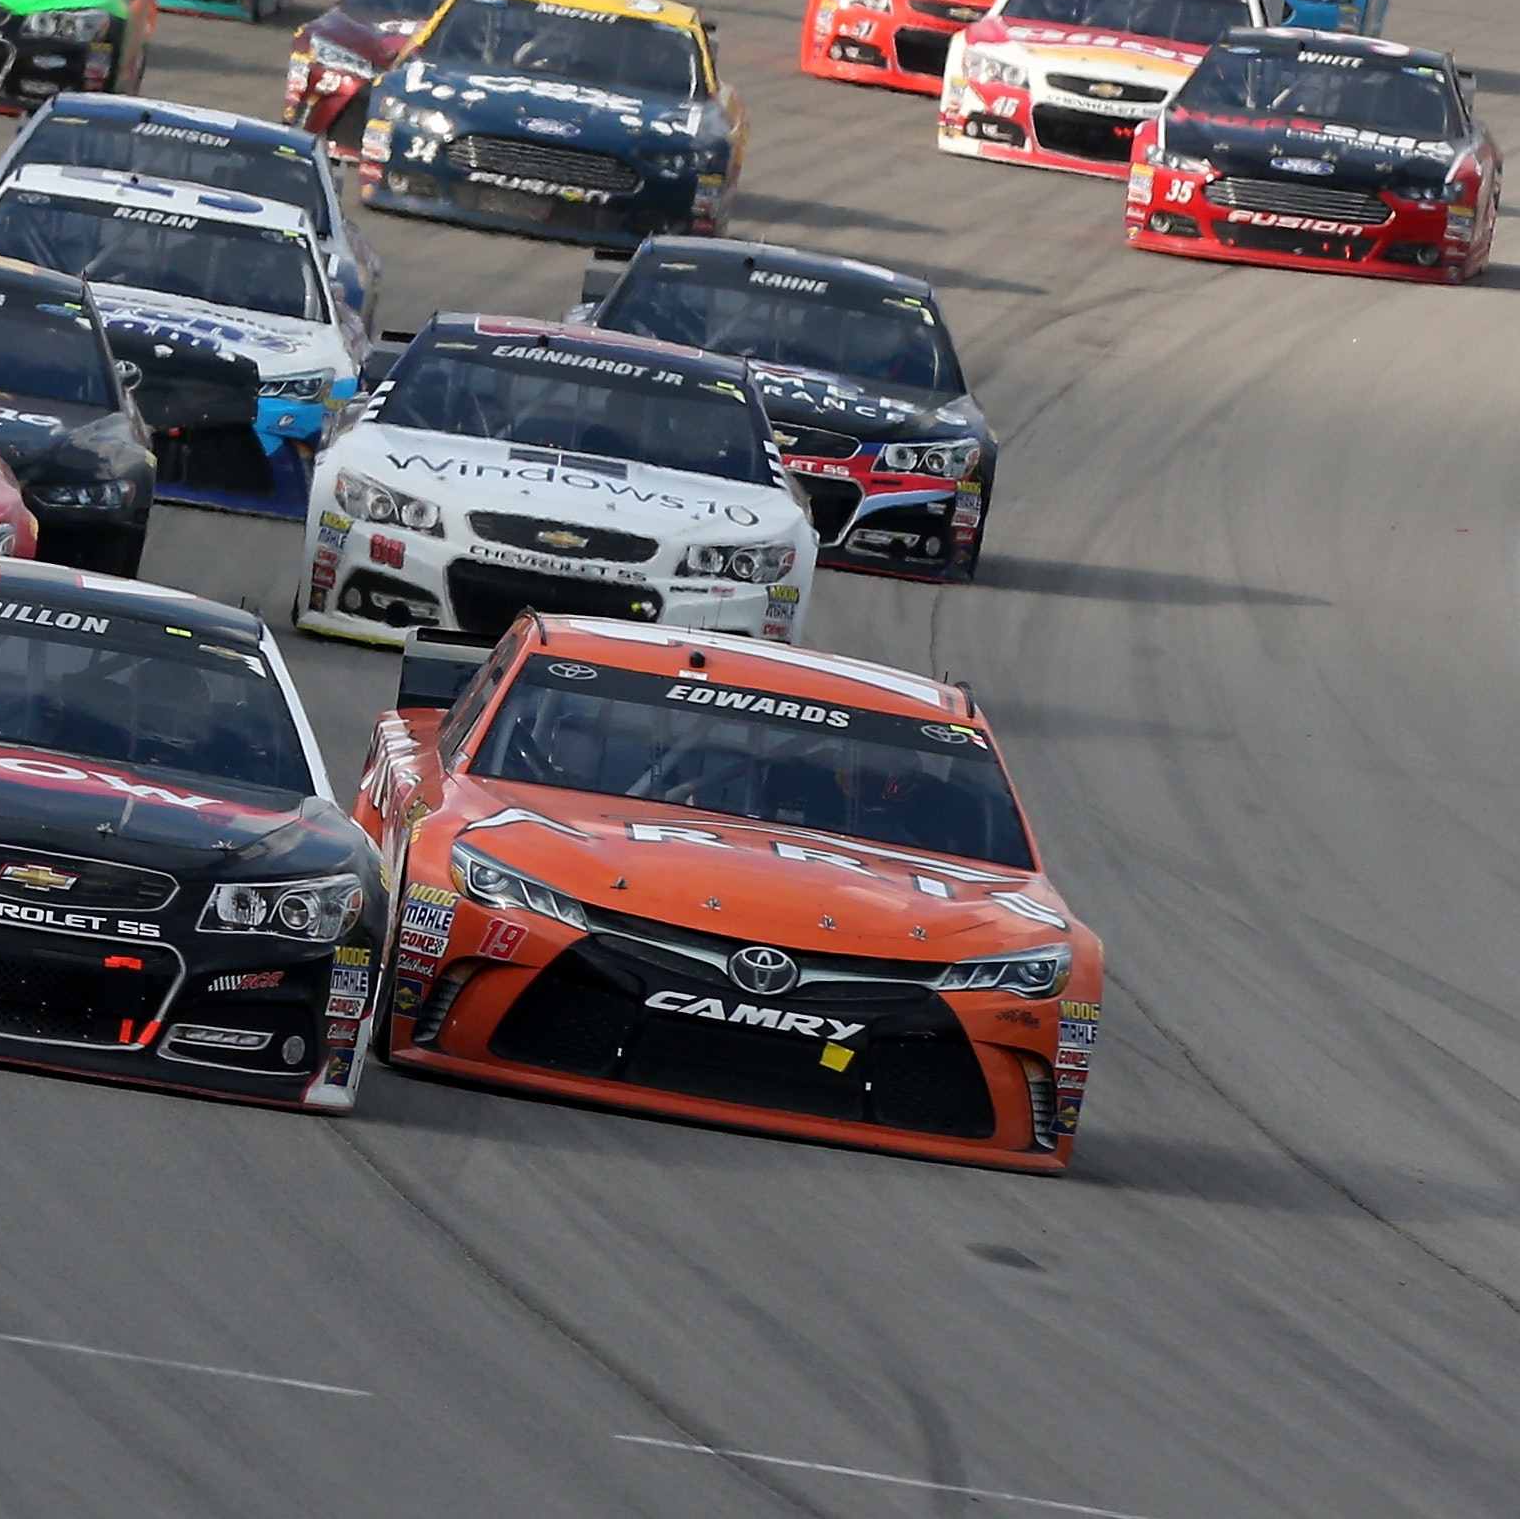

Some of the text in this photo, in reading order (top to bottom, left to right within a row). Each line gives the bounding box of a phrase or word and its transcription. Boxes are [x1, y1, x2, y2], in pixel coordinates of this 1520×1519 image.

[1297, 50, 1363, 69] WHITT
[131, 121, 230, 149] JOHNSON
[1164, 178, 1194, 204] 35
[113, 206, 199, 232] RAGAN
[1227, 208, 1364, 237] FUSION
[749, 269, 830, 295] KAHNE
[491, 345, 685, 387] EARNHARDT JR
[665, 683, 853, 730] EDWARDS
[406, 882, 461, 908] MOOG
[117, 920, 161, 938] SS
[404, 905, 454, 931] MAHLE
[400, 930, 435, 951] COMP
[477, 916, 530, 962] 19
[333, 946, 371, 968] MOOG
[236, 970, 285, 991] RCR
[643, 990, 867, 1041] CAMRY
[1061, 1000, 1100, 1021] MOOG
